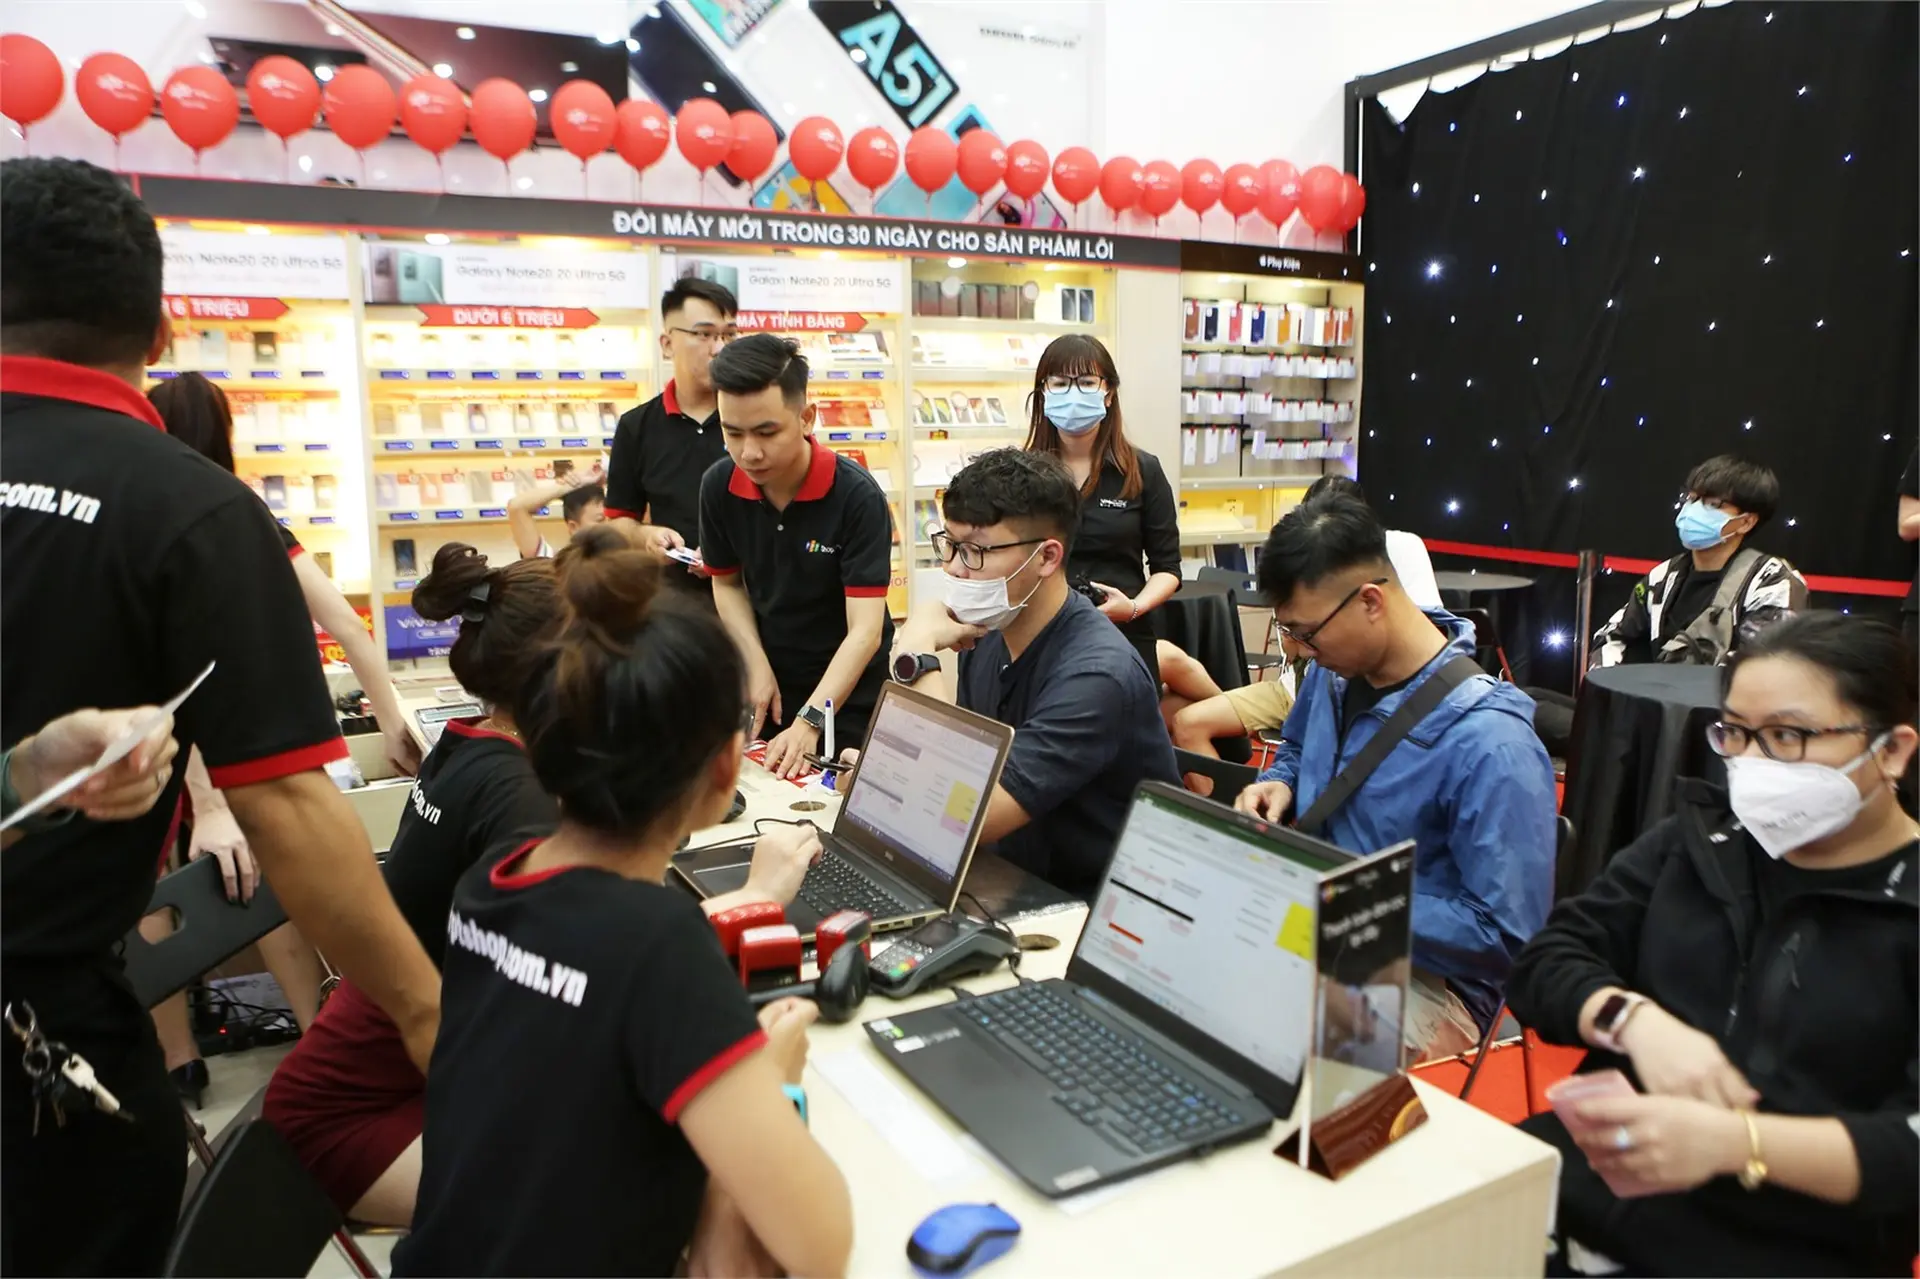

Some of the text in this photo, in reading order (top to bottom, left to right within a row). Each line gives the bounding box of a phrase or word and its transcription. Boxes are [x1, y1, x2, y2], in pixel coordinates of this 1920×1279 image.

[839, 11, 954, 128] A51
[662, 209, 714, 239] MÁY
[767, 218, 845, 246] TRONG
[847, 224, 871, 247] 30
[875, 223, 933, 250] NGÀY
[936, 229, 980, 252] CHO
[790, 275, 829, 288] Note20
[876, 278, 892, 289] 5G
